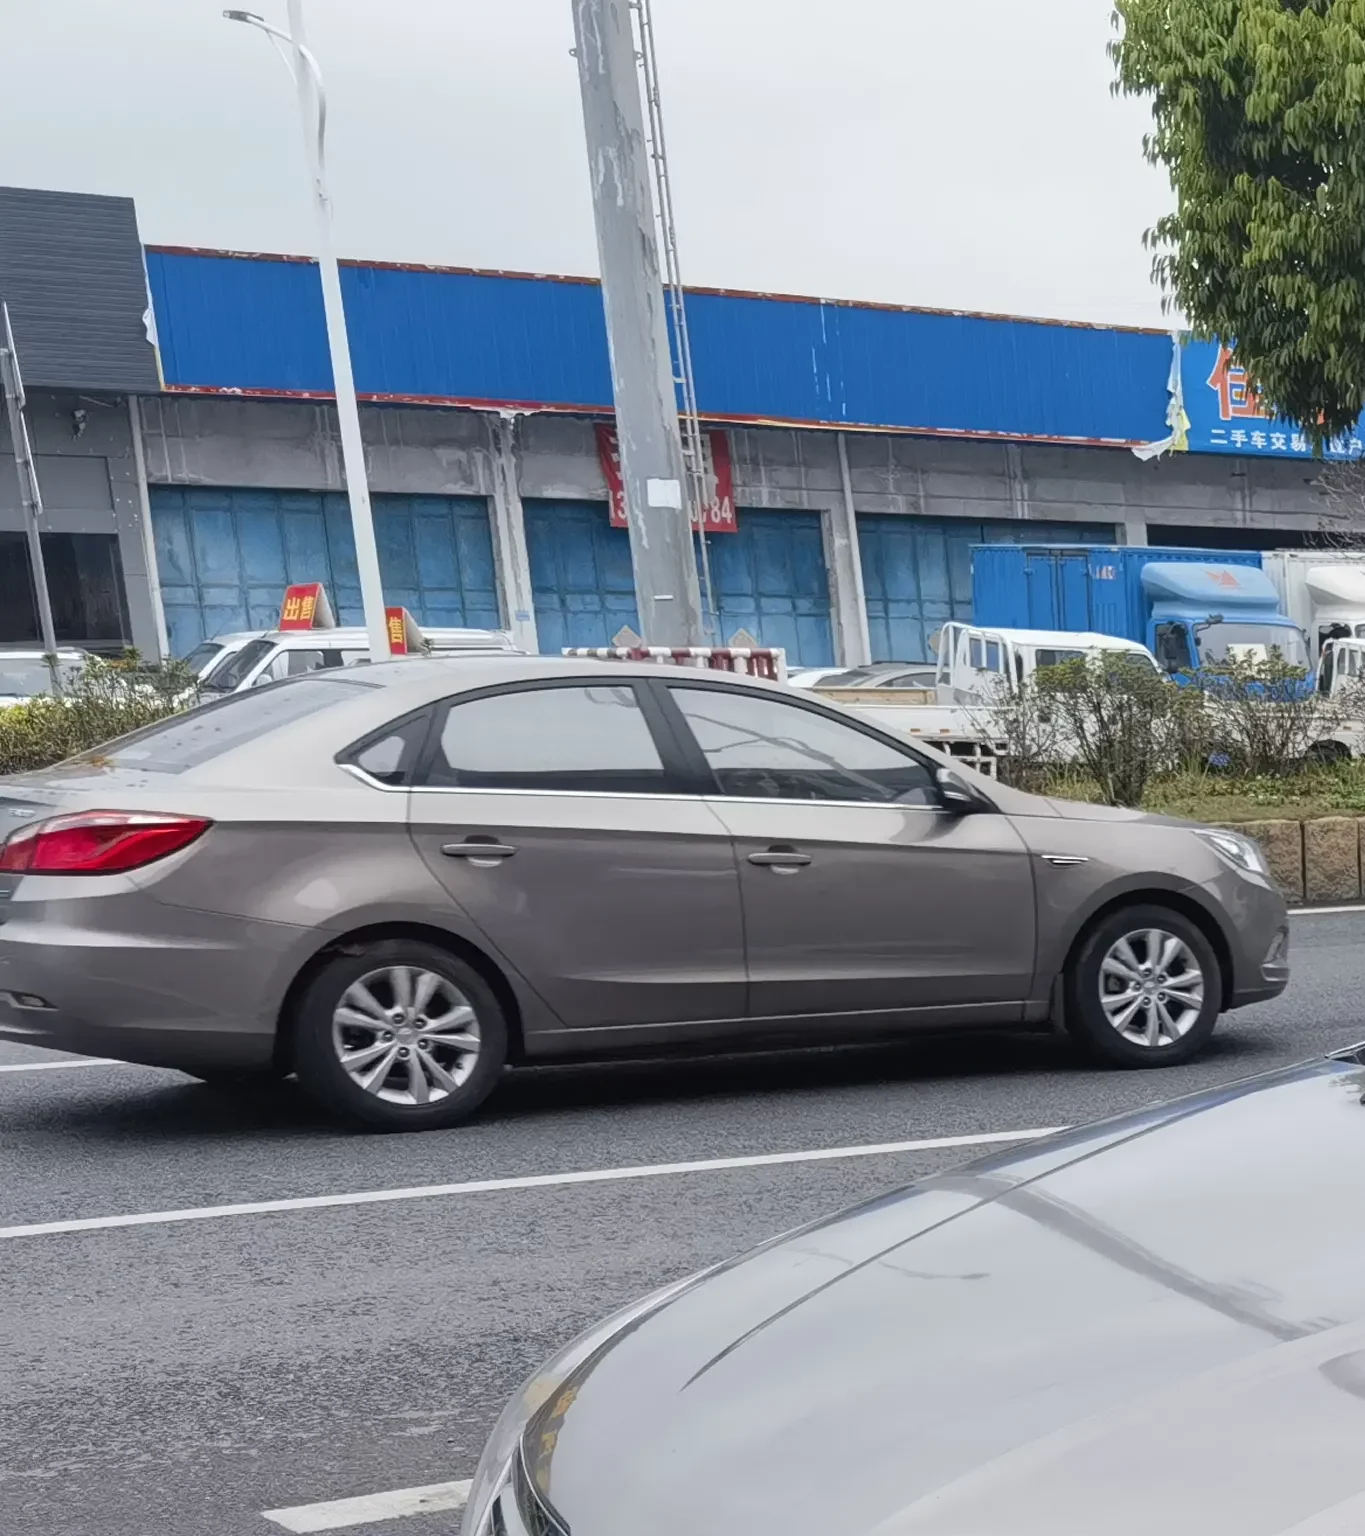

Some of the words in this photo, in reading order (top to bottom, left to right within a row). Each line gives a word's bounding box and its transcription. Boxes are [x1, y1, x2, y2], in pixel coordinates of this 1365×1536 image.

[1210, 428, 1306, 452] 二手车交易
[283, 595, 315, 621] 出售
